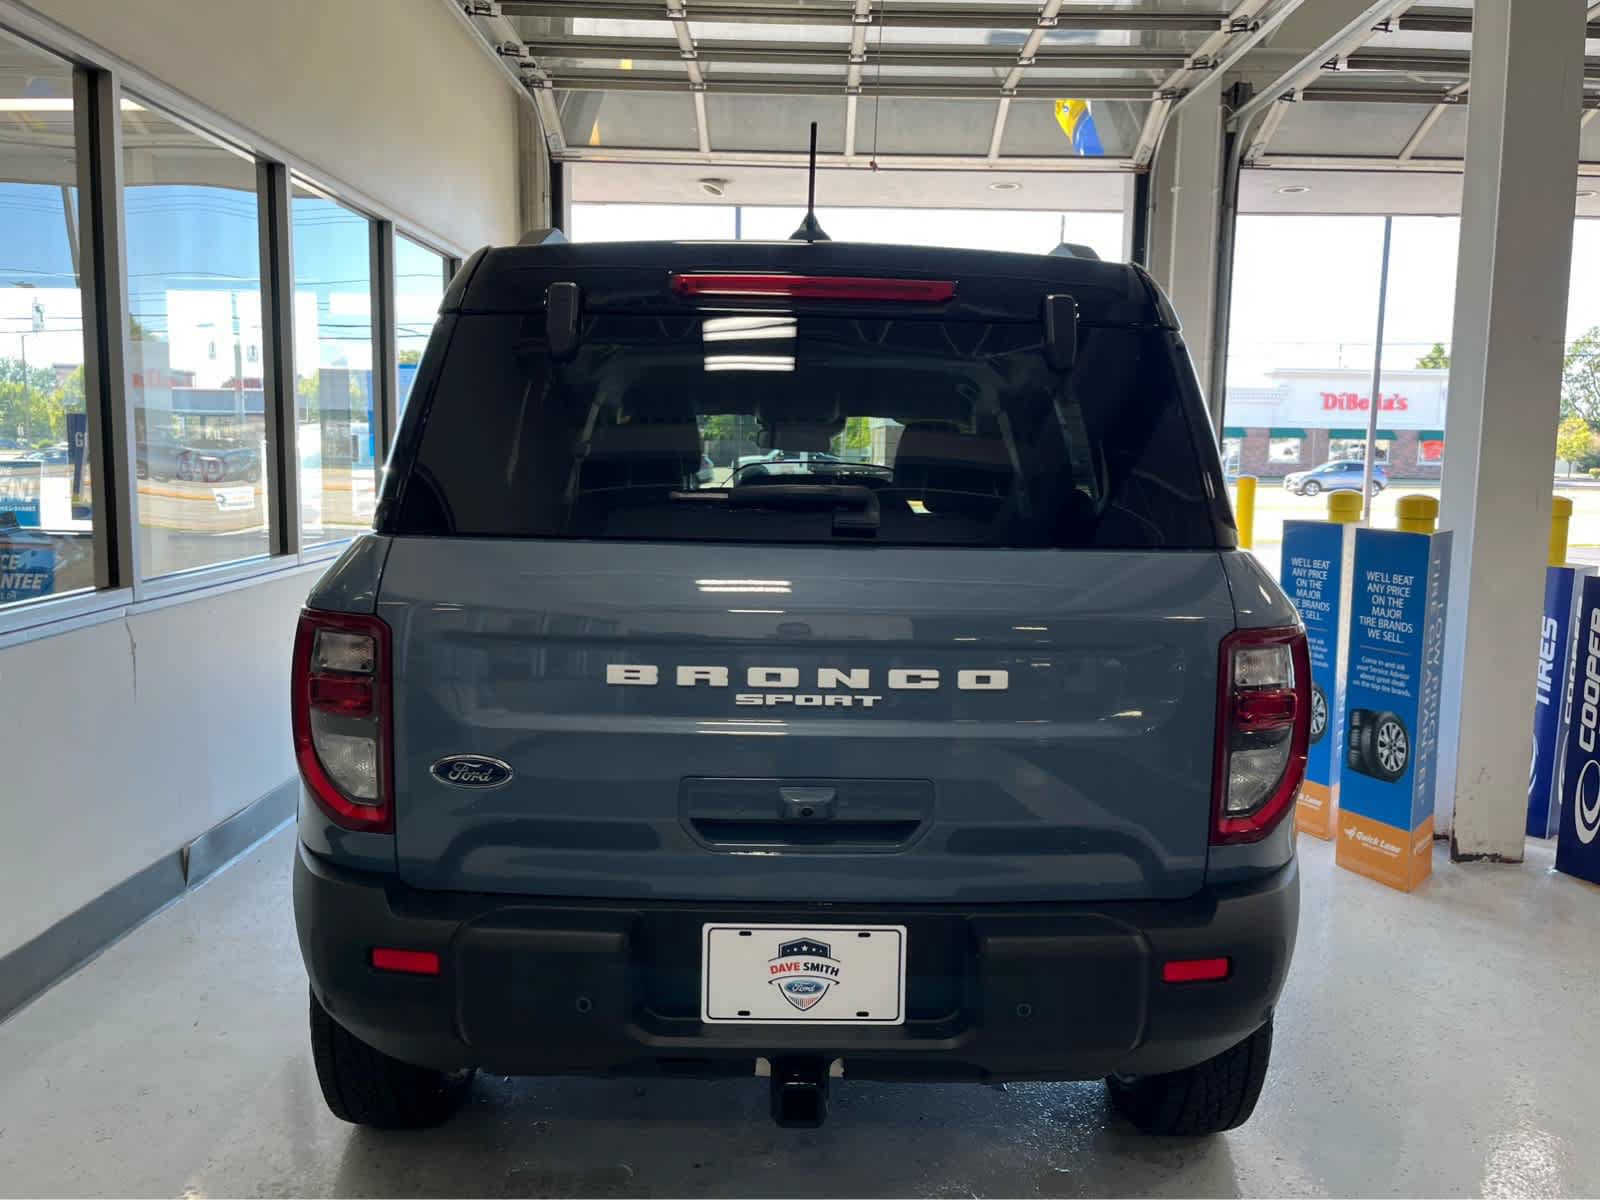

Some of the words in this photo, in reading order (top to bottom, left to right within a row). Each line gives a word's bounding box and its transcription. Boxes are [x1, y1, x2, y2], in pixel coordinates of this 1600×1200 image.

[1321, 392, 1409, 411] DiBela's
[1312, 560, 1331, 571] BEAT
[1292, 568, 1308, 577] ANY
[1308, 569, 1329, 580] PRICE
[1366, 571, 1390, 583] WE'LL
[1392, 574, 1414, 586] BEAT
[1296, 578, 1307, 587] ON
[1309, 580, 1324, 590] THE
[1367, 583, 1386, 593] ANY
[1386, 585, 1411, 598] PRICE
[1296, 588, 1322, 600] MAJOR
[1301, 600, 1330, 612] BRANDS
[1371, 595, 1386, 606] ON
[1387, 597, 1405, 609] THE
[1371, 606, 1402, 619] MAJOR
[1359, 615, 1377, 627] TIRE
[1378, 619, 1414, 634] BRANDS
[1367, 628, 1381, 639] WE
[1535, 615, 1559, 706] TIRES
[606, 664, 1010, 691] BRONCO
[735, 693, 883, 707] SPORT
[448, 761, 494, 782] Ford
[1356, 831, 1380, 846] Quick
[770, 961, 801, 975] DAVE
[803, 961, 840, 977] SMITH
[791, 982, 816, 993] Ford
